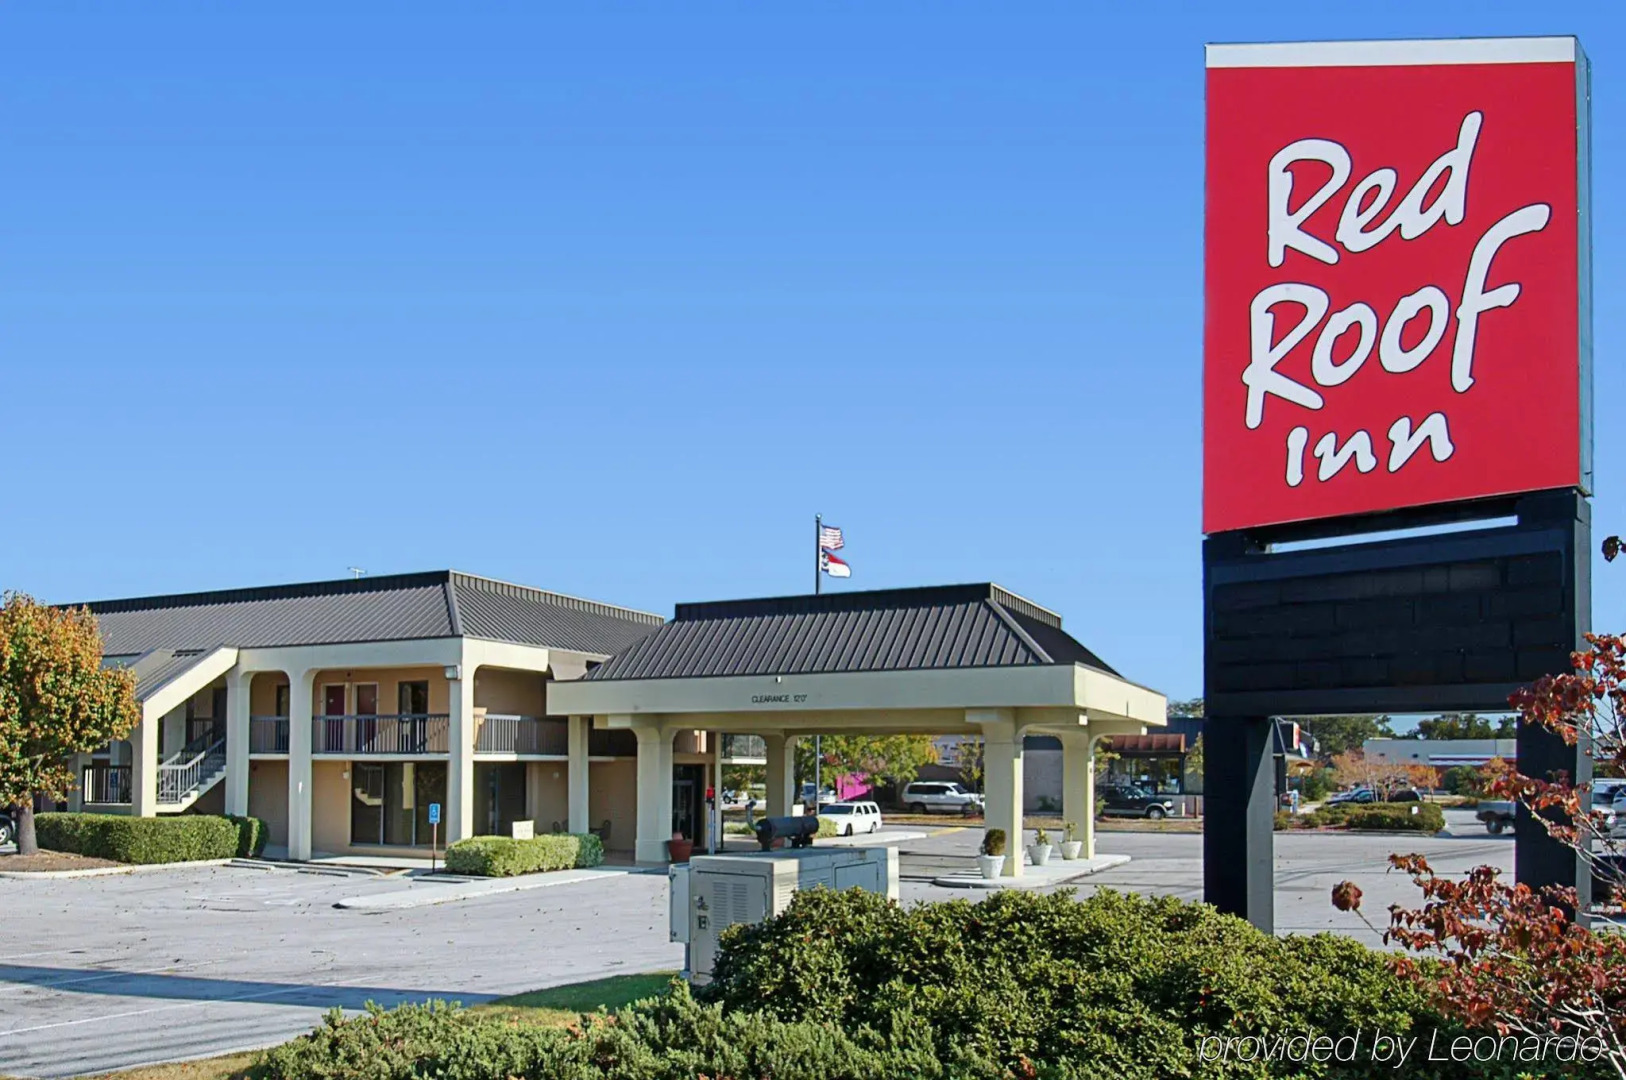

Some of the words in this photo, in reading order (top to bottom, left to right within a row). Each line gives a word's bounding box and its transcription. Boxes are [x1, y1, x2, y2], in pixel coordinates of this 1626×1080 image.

[1267, 110, 1484, 268] Red
[1242, 203, 1552, 430] Roof
[1285, 412, 1456, 487] Inn
[751, 694, 790, 703] CLEARANCE
